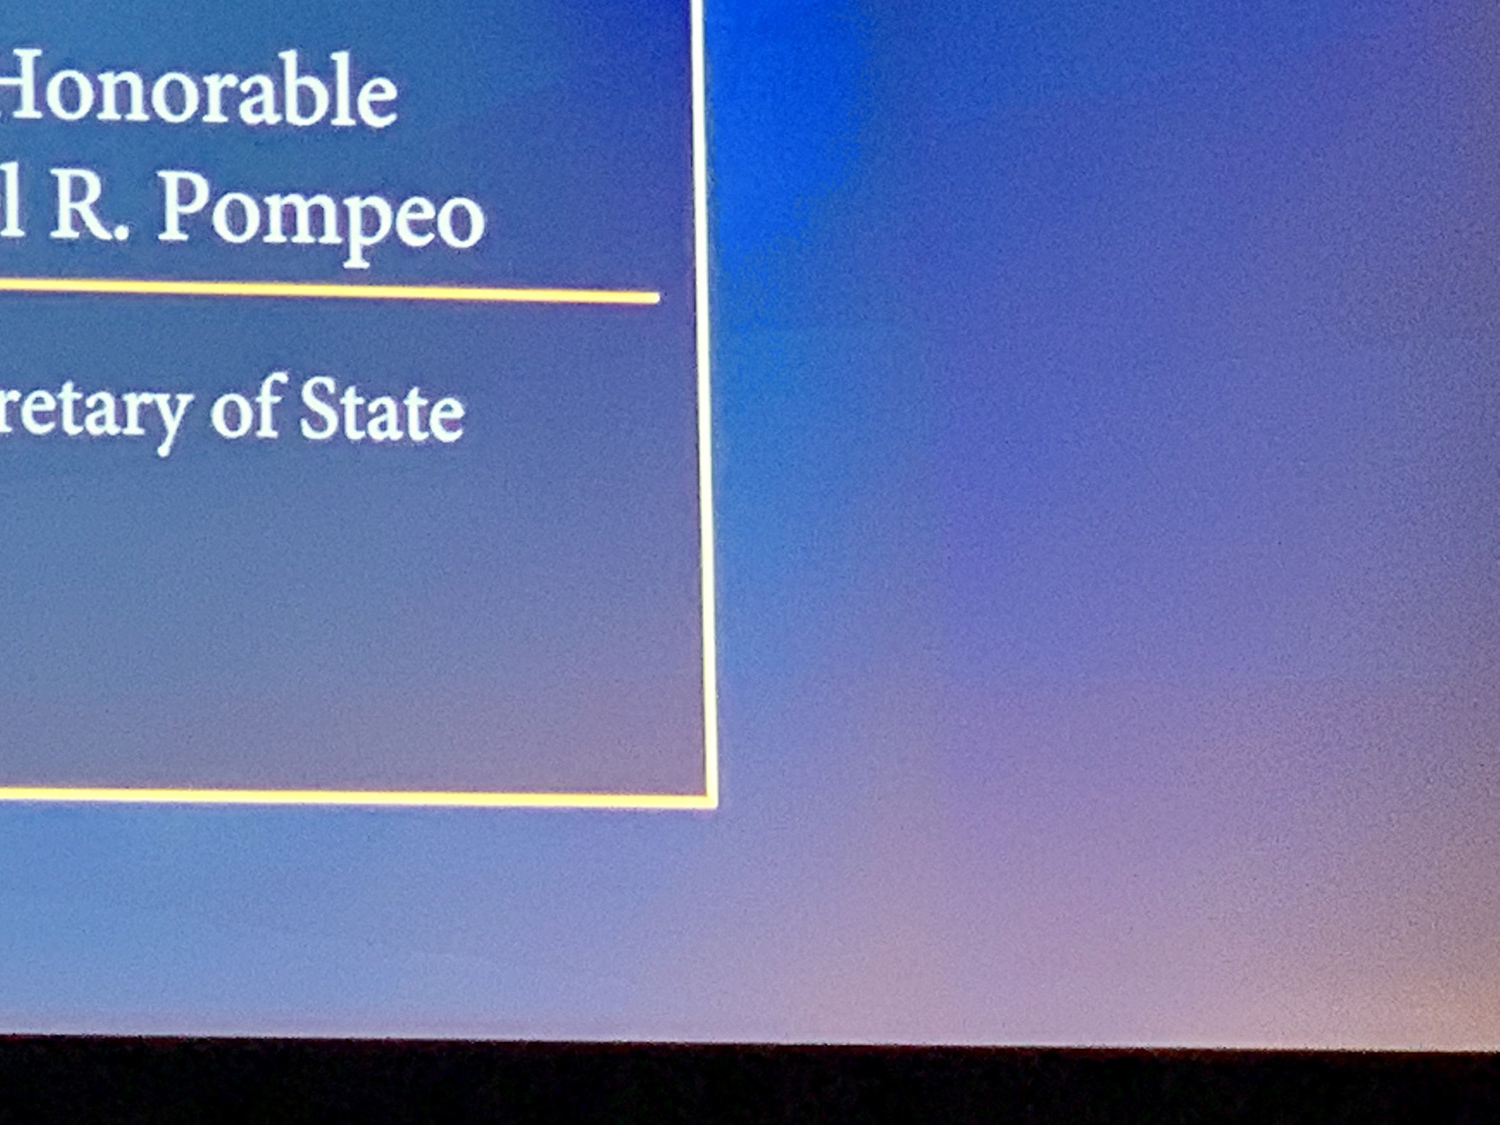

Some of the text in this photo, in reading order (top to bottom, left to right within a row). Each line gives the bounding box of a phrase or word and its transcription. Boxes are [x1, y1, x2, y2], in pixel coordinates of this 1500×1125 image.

[50, 168, 130, 242] R.
[157, 170, 486, 270] Pompeo
[211, 372, 289, 440] of
[301, 376, 465, 443] State
